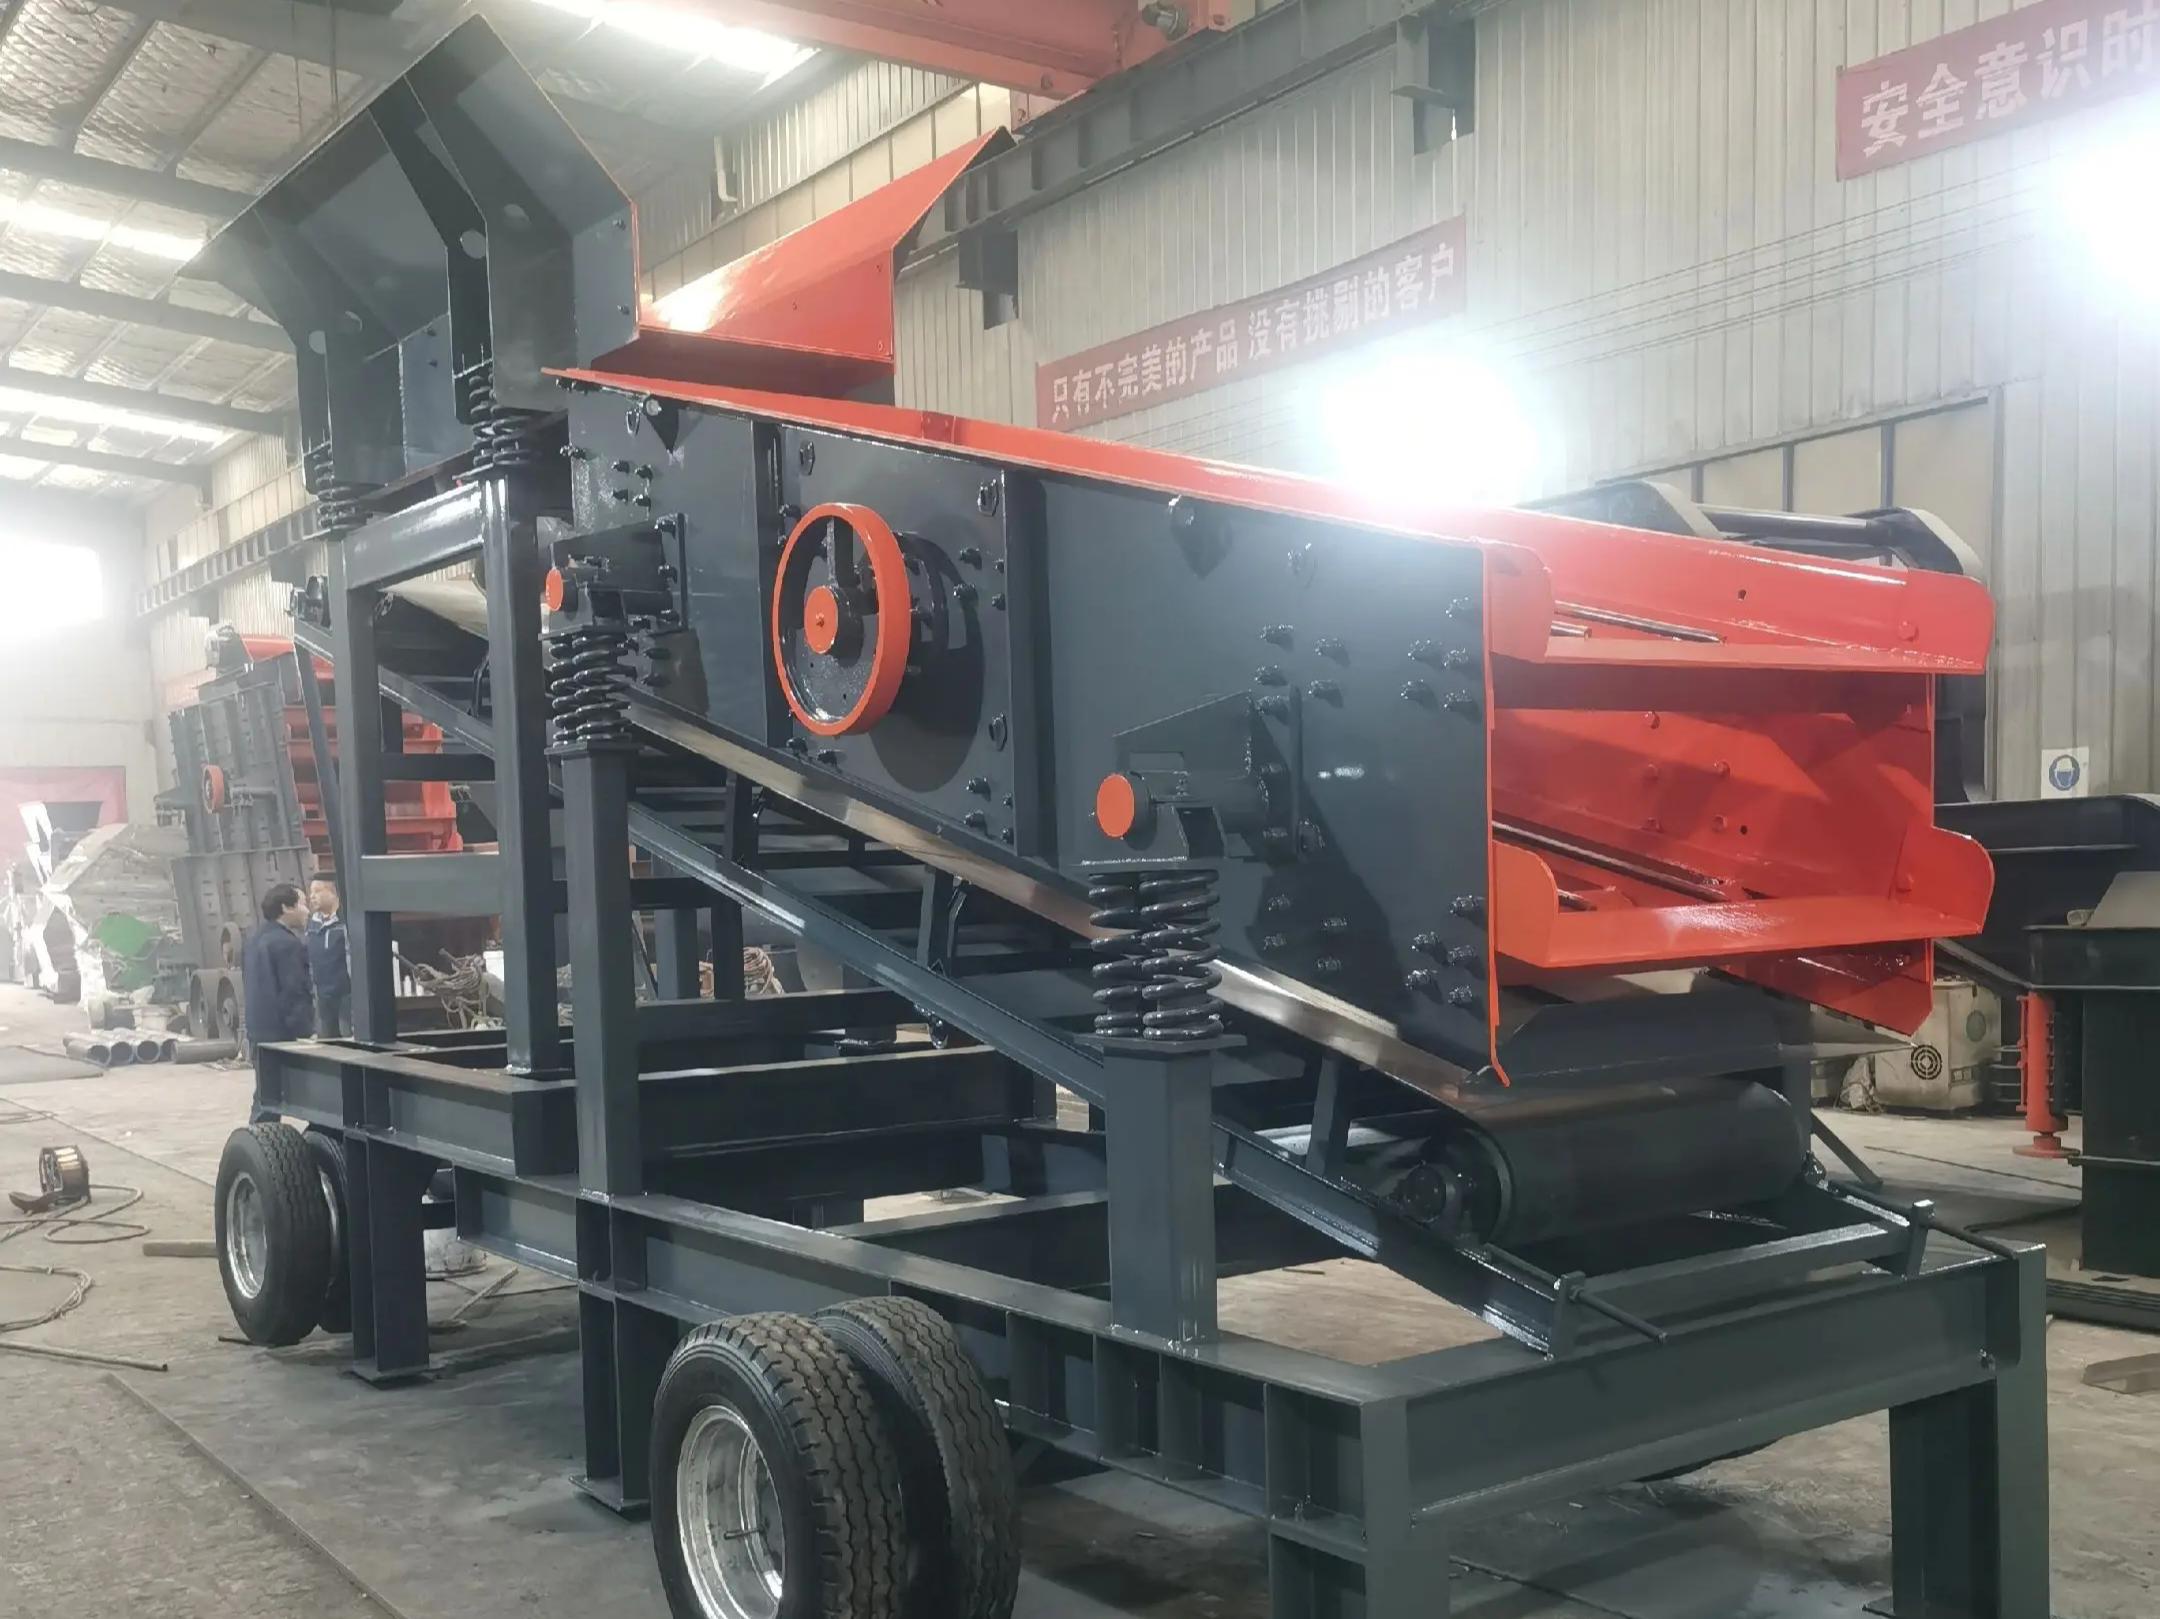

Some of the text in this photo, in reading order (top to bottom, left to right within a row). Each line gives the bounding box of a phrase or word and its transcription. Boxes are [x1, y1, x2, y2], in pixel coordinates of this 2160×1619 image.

[1052, 242, 1455, 423] 只有不完美的产品 没有挑剔的客户
